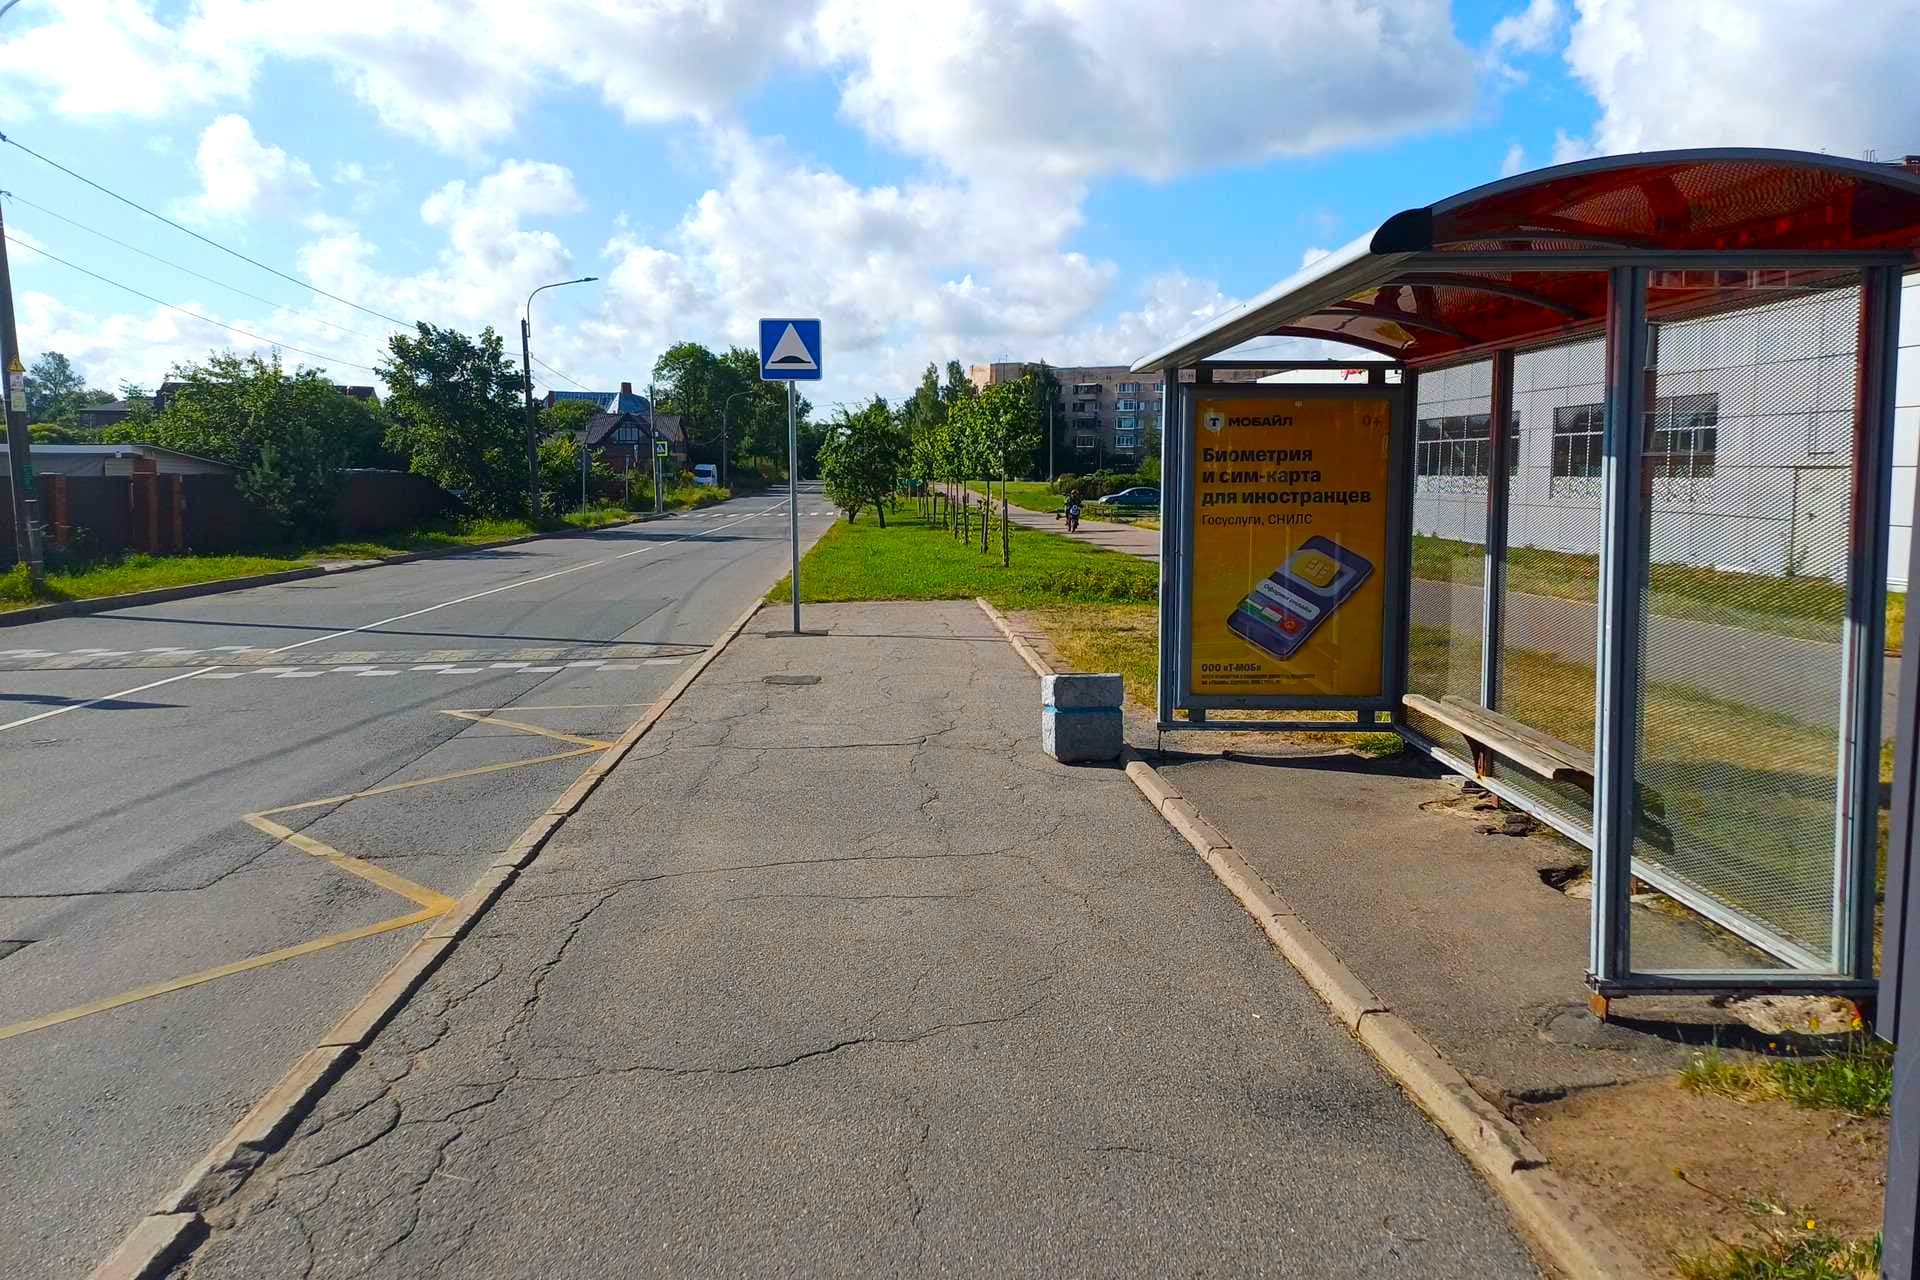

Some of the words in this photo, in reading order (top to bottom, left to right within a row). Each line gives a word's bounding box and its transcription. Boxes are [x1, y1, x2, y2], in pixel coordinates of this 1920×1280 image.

[1229, 414, 1293, 427] МОБАЙЛ
[1362, 415, 1383, 427] 0+
[1203, 448, 1313, 465] Биометрия
[1202, 471, 1214, 483] и
[1219, 470, 1321, 485] сим-карта
[1202, 491, 1237, 506] для
[1242, 490, 1371, 506] иностранцев
[1202, 514, 1264, 528] Госуслуги,
[1268, 513, 1313, 525] СНИЛС
[1201, 663, 1220, 672] ООО
